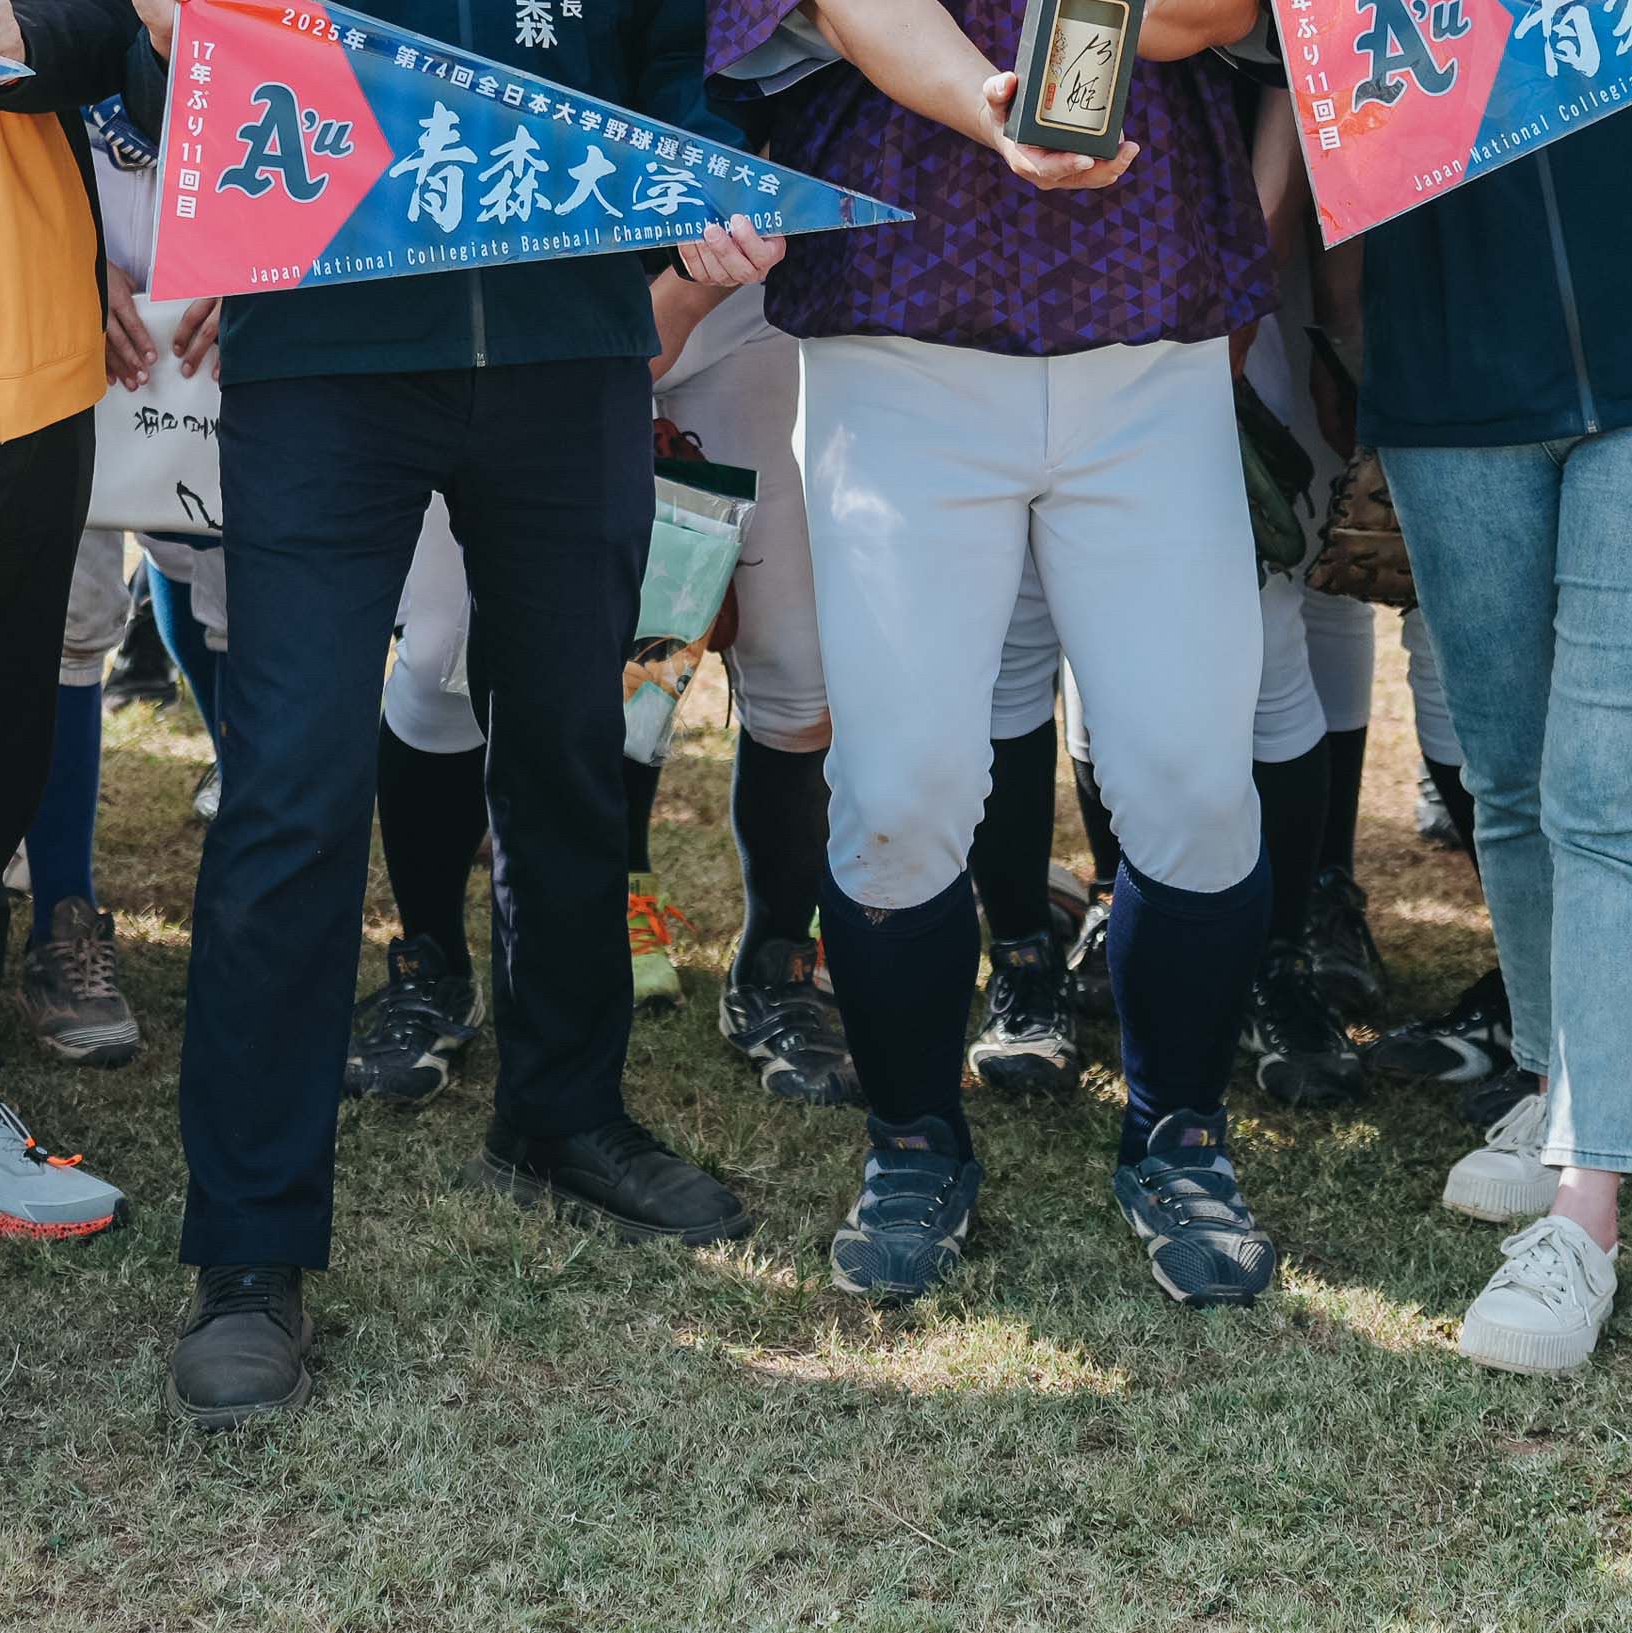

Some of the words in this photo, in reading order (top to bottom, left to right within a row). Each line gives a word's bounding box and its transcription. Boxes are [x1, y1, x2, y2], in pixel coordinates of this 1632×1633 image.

[176, 40, 216, 219] 17年ぶり11回目
[281, 8, 368, 52] 2025年
[393, 44, 782, 196] 第74回全日本大学野球選手権大会
[389, 100, 706, 234] 青森大学
[1413, 158, 1464, 193] Japan
[1469, 113, 1550, 165] National
[250, 264, 301, 284] Japan
[312, 251, 393, 277] National
[407, 239, 510, 266] Collegiate
[521, 227, 601, 250] Baseball
[744, 211, 783, 230] 025
